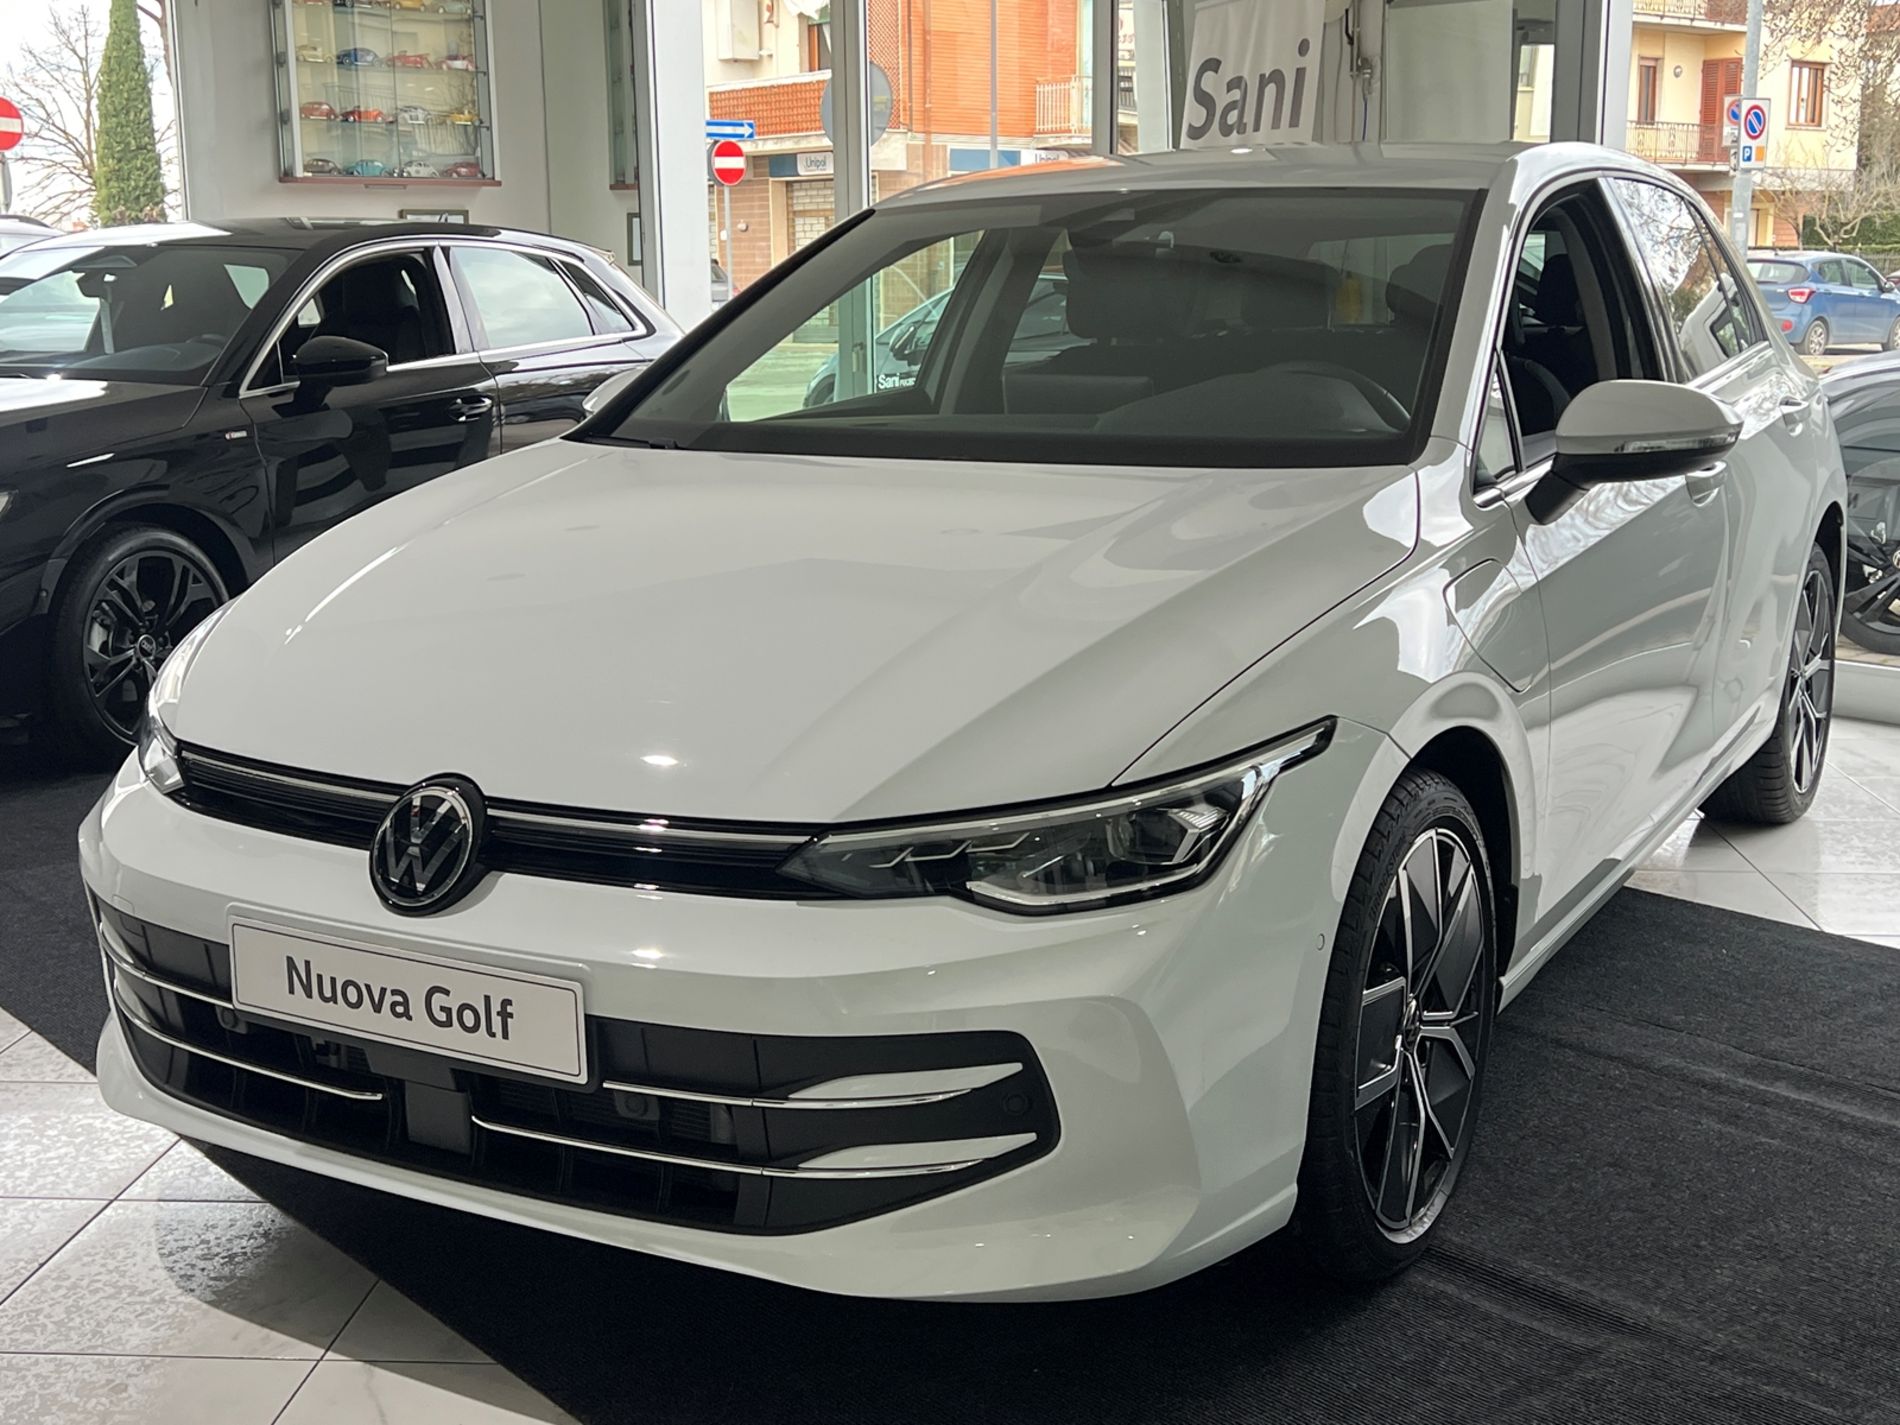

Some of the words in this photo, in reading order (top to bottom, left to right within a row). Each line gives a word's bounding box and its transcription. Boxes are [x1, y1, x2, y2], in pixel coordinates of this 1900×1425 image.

[1186, 38, 1310, 140] Sani
[805, 155, 827, 168] Unipol
[878, 372, 900, 389] Sani
[286, 955, 413, 1022] Nuova
[424, 986, 514, 1040] Golf
